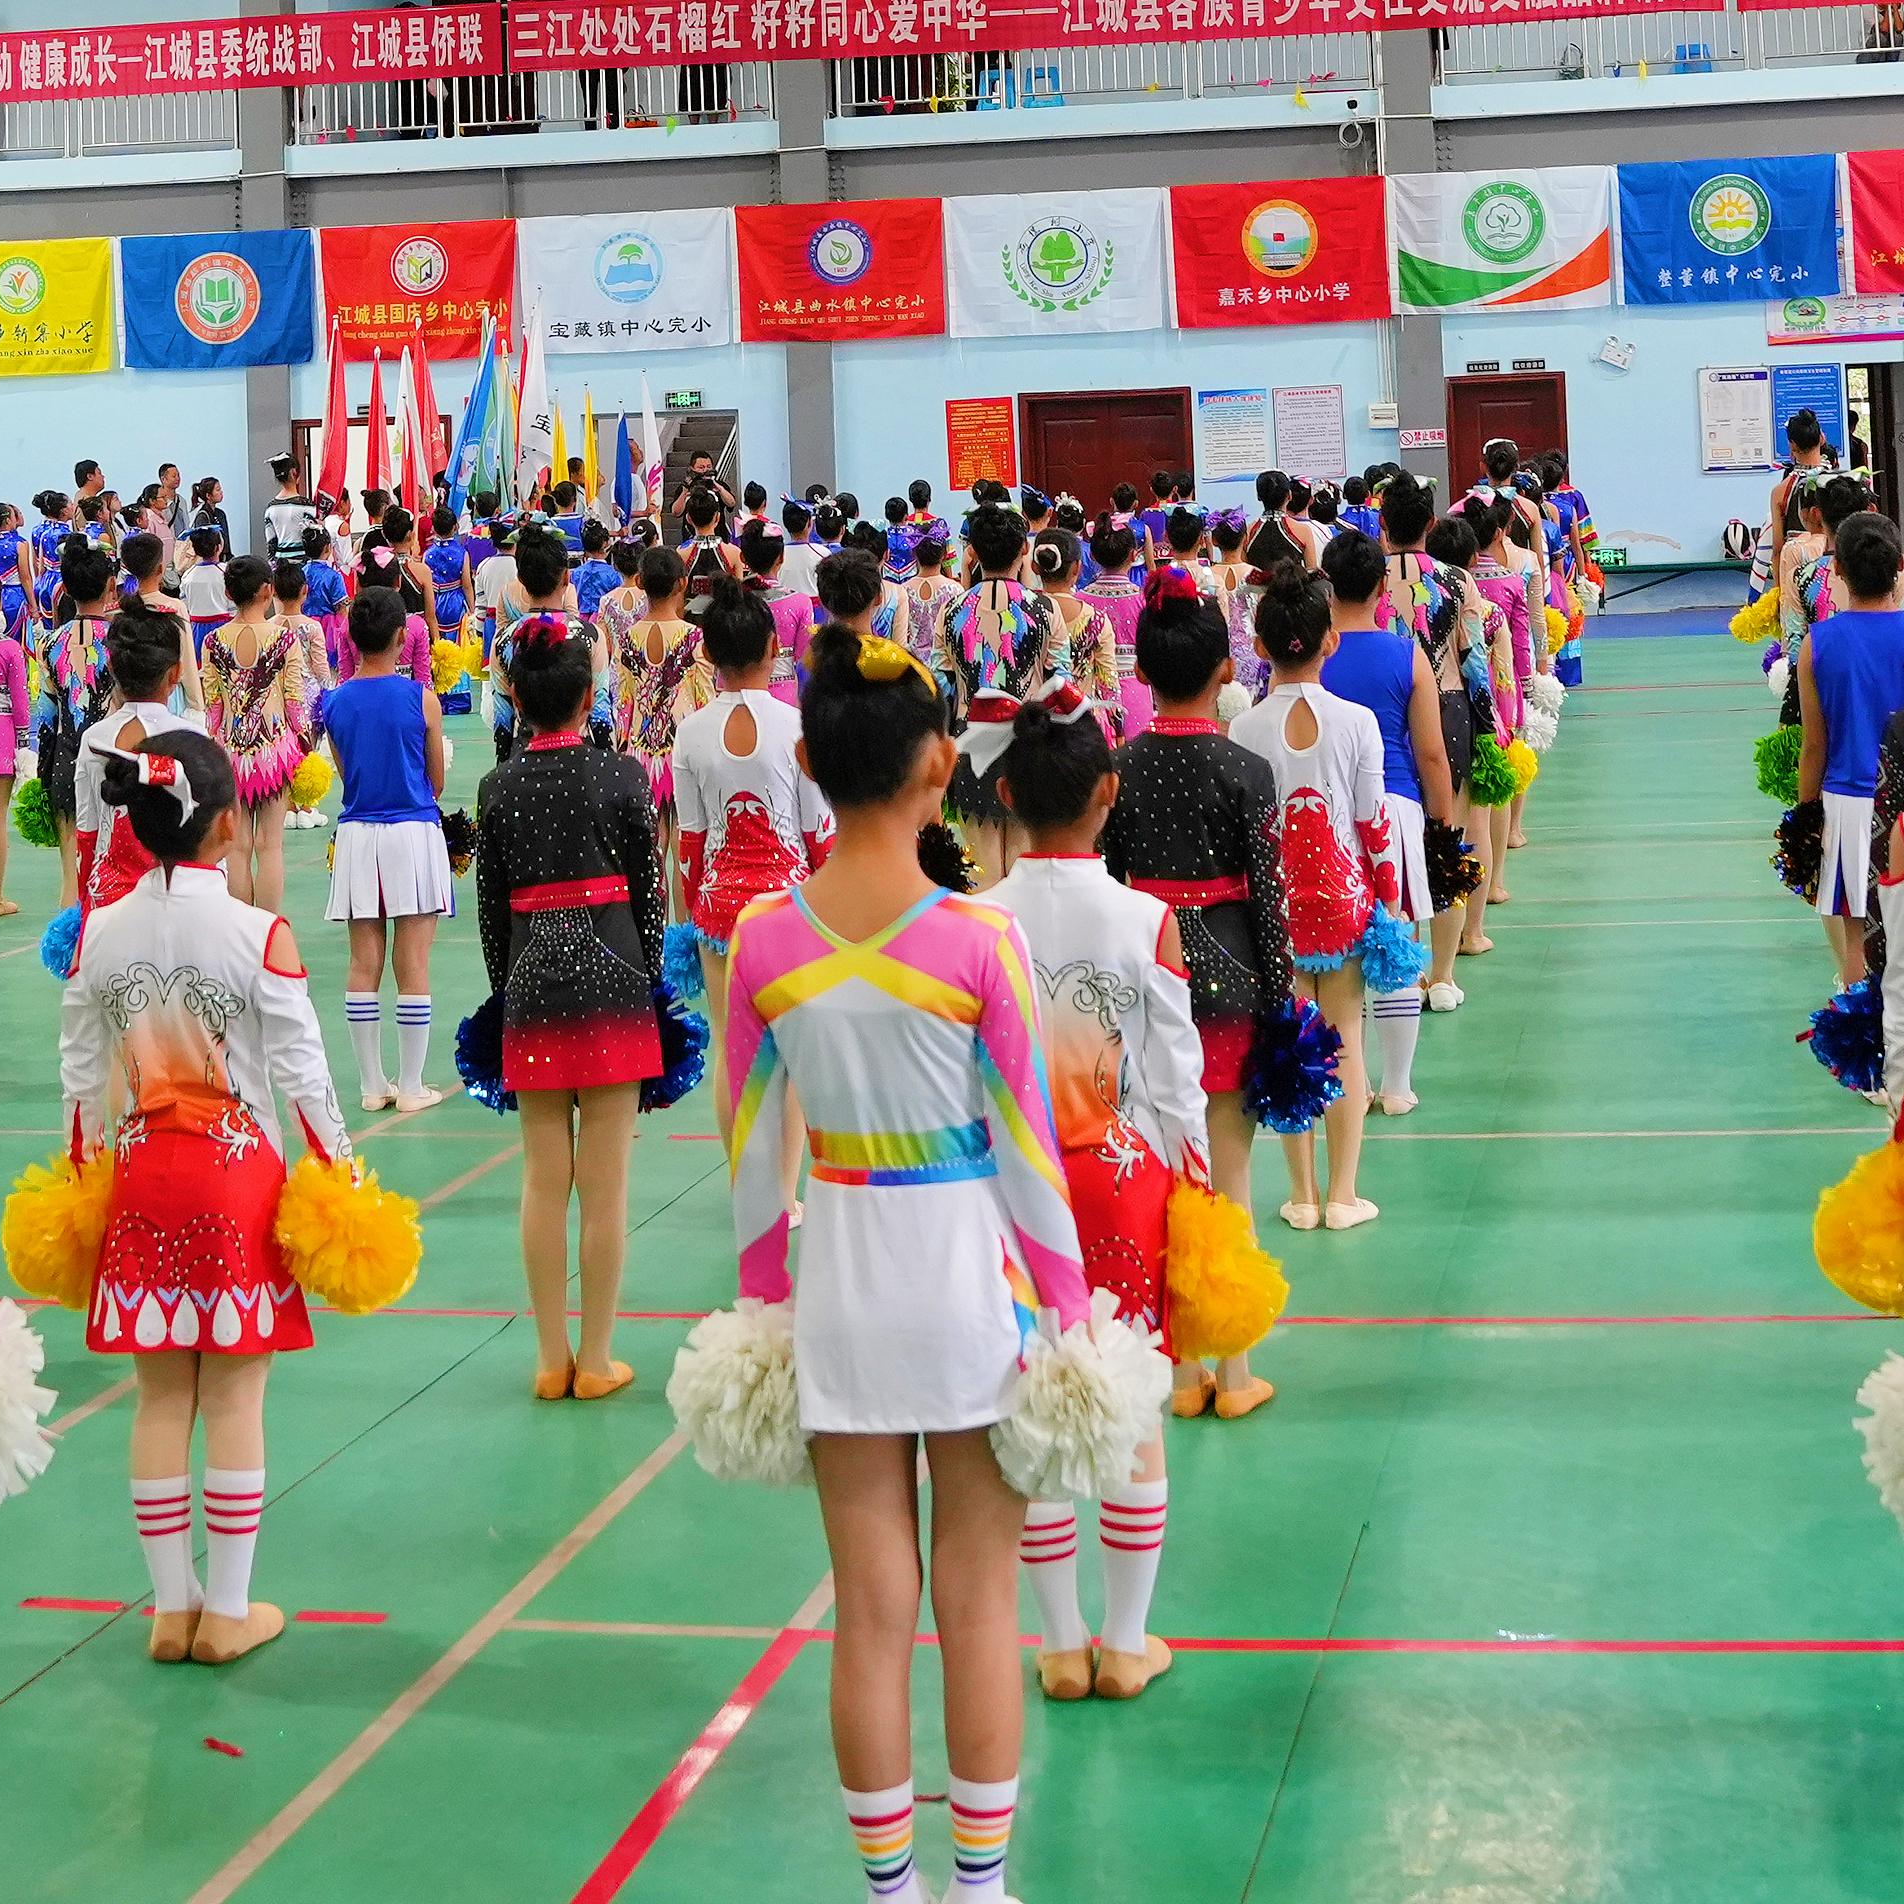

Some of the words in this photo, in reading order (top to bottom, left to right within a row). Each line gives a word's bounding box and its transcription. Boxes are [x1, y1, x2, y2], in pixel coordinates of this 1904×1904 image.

[512, 1, 743, 59] 三江处处石榴红
[1656, 264, 1810, 287] 整董镇中心完小
[757, 294, 925, 314] 江城县曲水镇中心完小
[1216, 282, 1351, 307] 嘉禾乡中心小学
[337, 297, 509, 326] 江城县国庆乡中心完小
[547, 316, 712, 339] 宝藏镇中心完小
